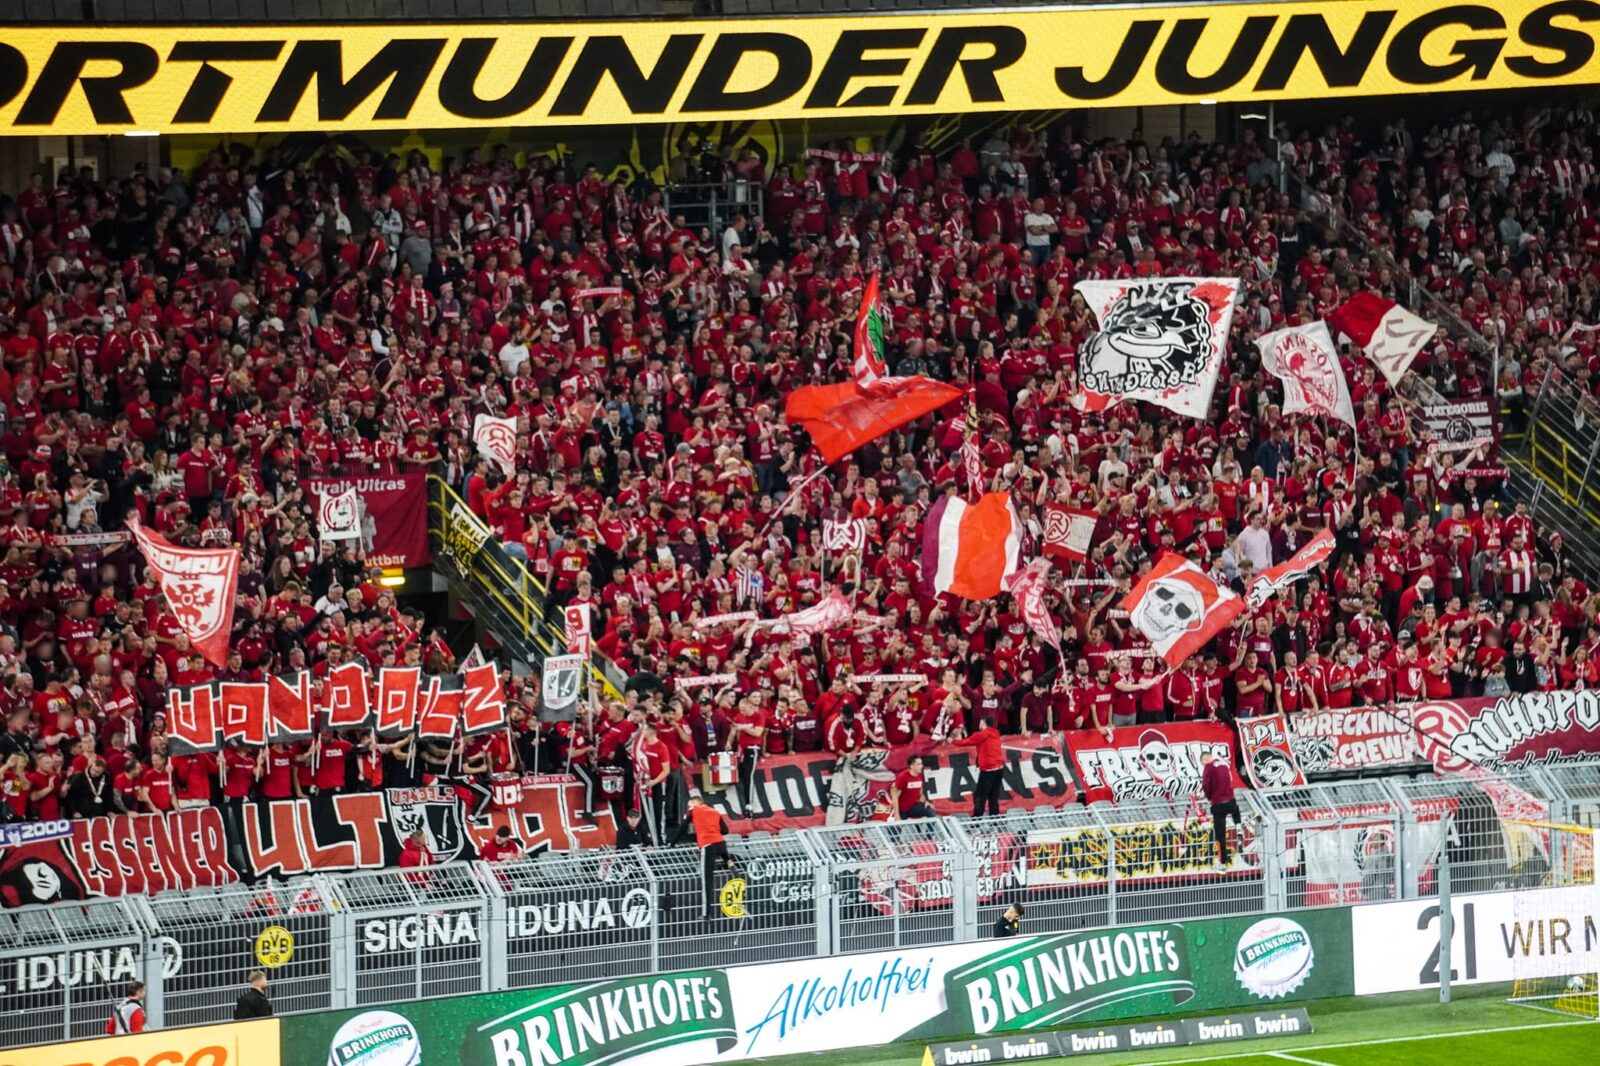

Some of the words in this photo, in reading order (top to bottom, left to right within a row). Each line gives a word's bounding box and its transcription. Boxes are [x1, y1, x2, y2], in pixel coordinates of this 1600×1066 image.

[0, 26, 1027, 126] RTMUNDER
[1055, 0, 1597, 99] JUNGS
[364, 554, 406, 567] uttbar
[1242, 721, 1284, 747] LPL
[1299, 706, 1411, 737] WRECKING
[1450, 689, 1600, 762] RUHRPO
[1339, 736, 1400, 765] CREW
[20, 819, 71, 839] 2000
[70, 806, 240, 898] ESSENER
[507, 897, 616, 938] IDUNA
[1501, 917, 1572, 959] WIR
[261, 931, 289, 956] BVB
[1417, 903, 1477, 984] 21
[17, 946, 137, 991] IDUNA
[965, 930, 1179, 1034] BRINKHOFF's
[490, 976, 723, 1066] BRINKHOFF's
[745, 956, 934, 1055] Alkoholfrei
[1071, 1031, 1117, 1052] bwin
[1130, 1026, 1175, 1047] bwin
[1198, 1019, 1243, 1041] bwin
[1254, 1013, 1299, 1035] bwin
[945, 1044, 991, 1066] bwin
[1002, 1038, 1048, 1059] bwin
